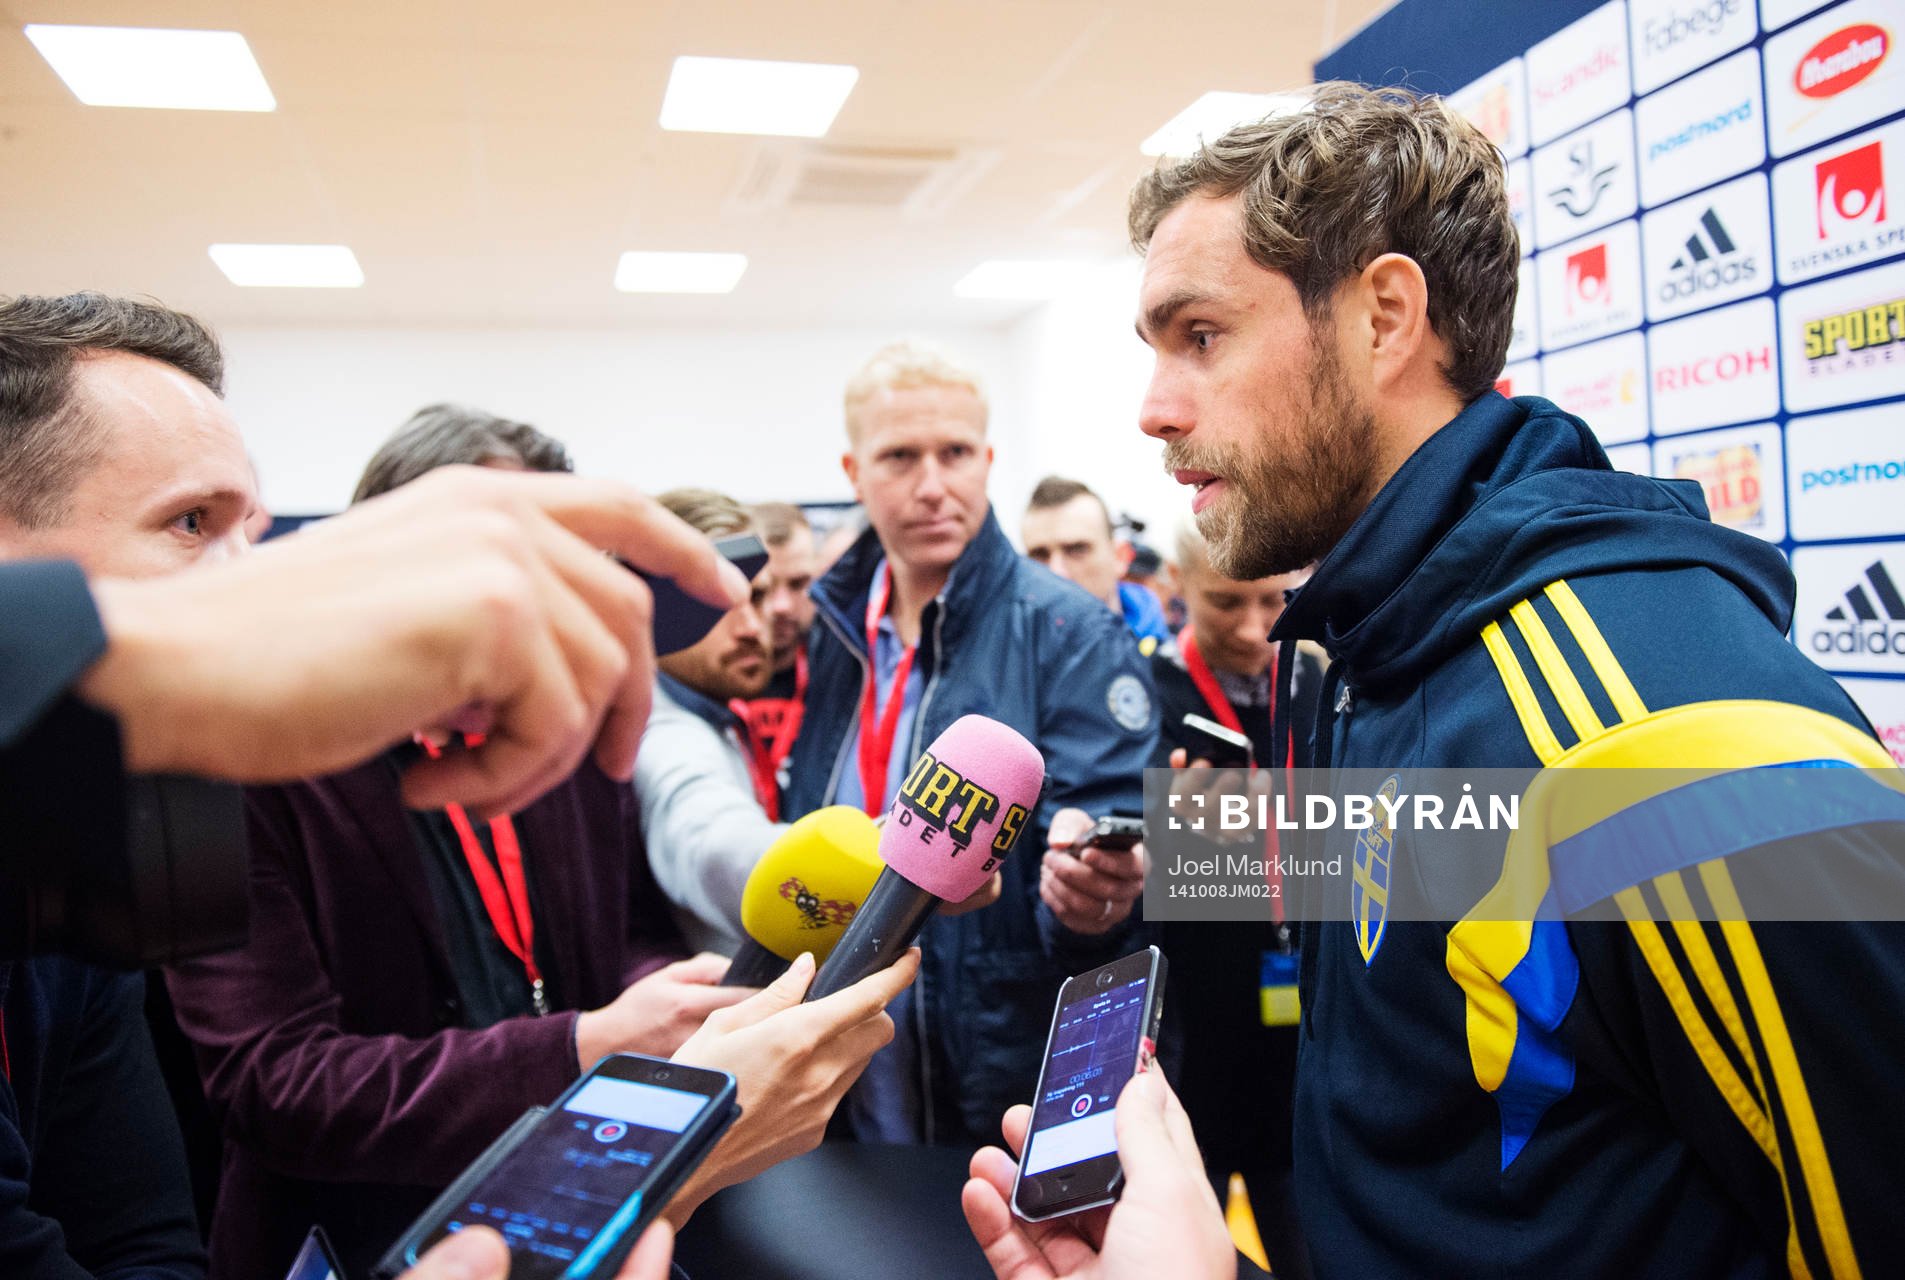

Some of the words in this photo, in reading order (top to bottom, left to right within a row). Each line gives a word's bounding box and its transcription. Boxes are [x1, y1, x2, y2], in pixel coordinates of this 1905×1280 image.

[1645, 0, 1740, 53] Fabege
[1650, 98, 1751, 160] postnord
[1790, 239, 1868, 270] SVENSKA
[1659, 256, 1756, 302] adidas
[1656, 347, 1771, 393] RICOH
[1802, 460, 1905, 491] postno
